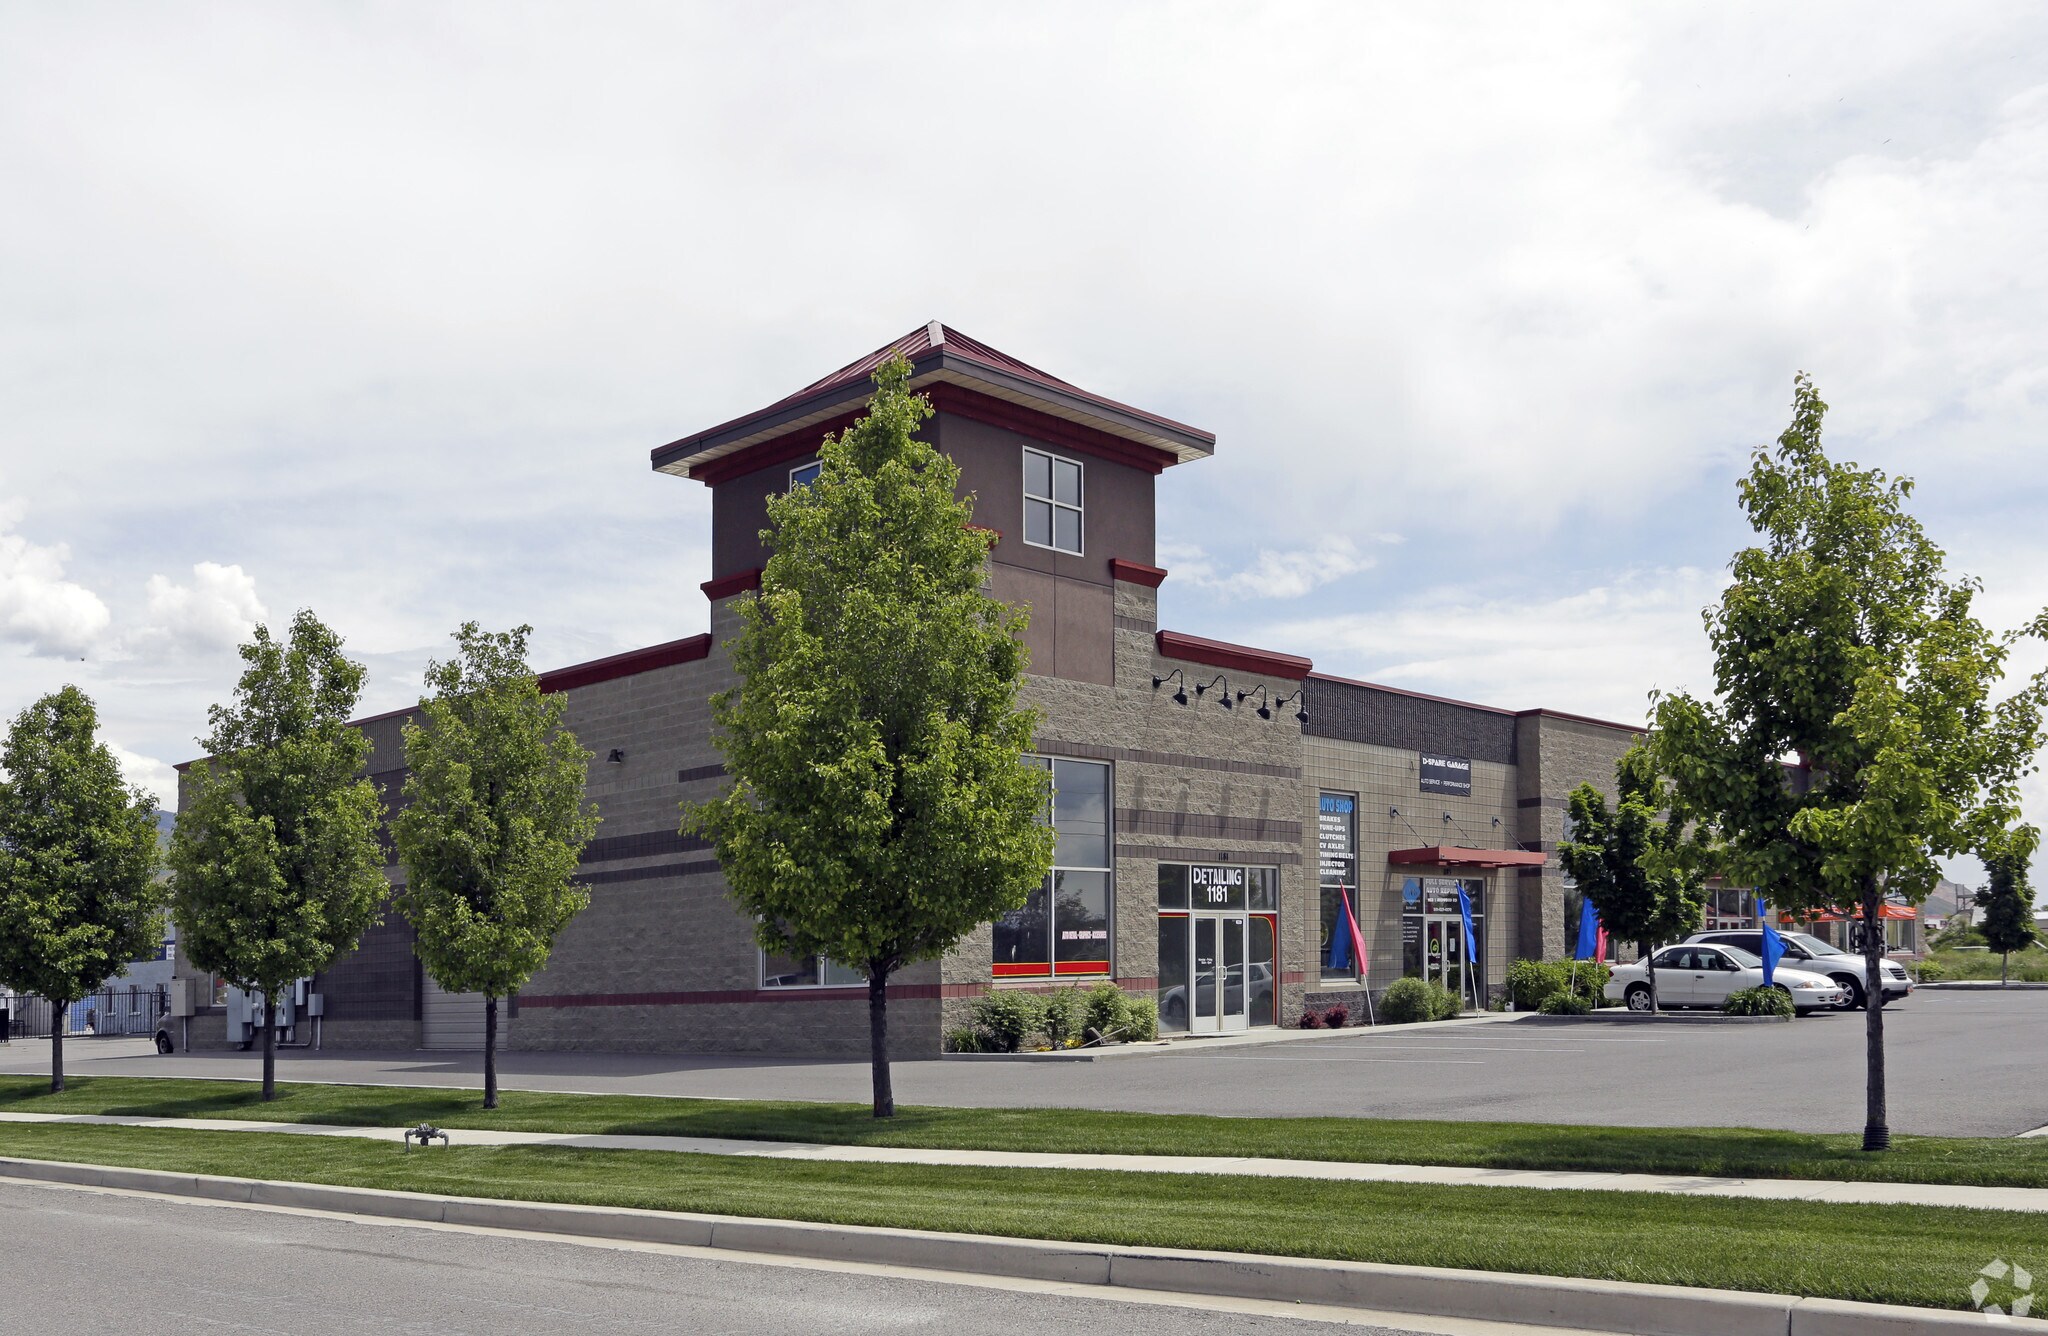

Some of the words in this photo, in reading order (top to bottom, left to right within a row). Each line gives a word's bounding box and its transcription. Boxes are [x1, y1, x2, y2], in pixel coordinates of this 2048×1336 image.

[1422, 757, 1446, 767] D-SPARE
[1446, 760, 1469, 770] GARAGE
[1319, 797, 1335, 812] UTO
[1335, 799, 1353, 814] SHOP
[1319, 815, 1341, 823] BRAKES
[1319, 824, 1346, 832] TUNE-UPS
[1320, 833, 1346, 841] CLUTCHES
[1320, 851, 1338, 859] TIMING
[1338, 852, 1354, 860] BELTS
[1320, 860, 1346, 868] INJECTOR
[1320, 868, 1346, 876] CLEANING
[1193, 867, 1242, 886] DETAILING
[1206, 885, 1228, 903] 1181
[1425, 886, 1440, 894] AUTO
